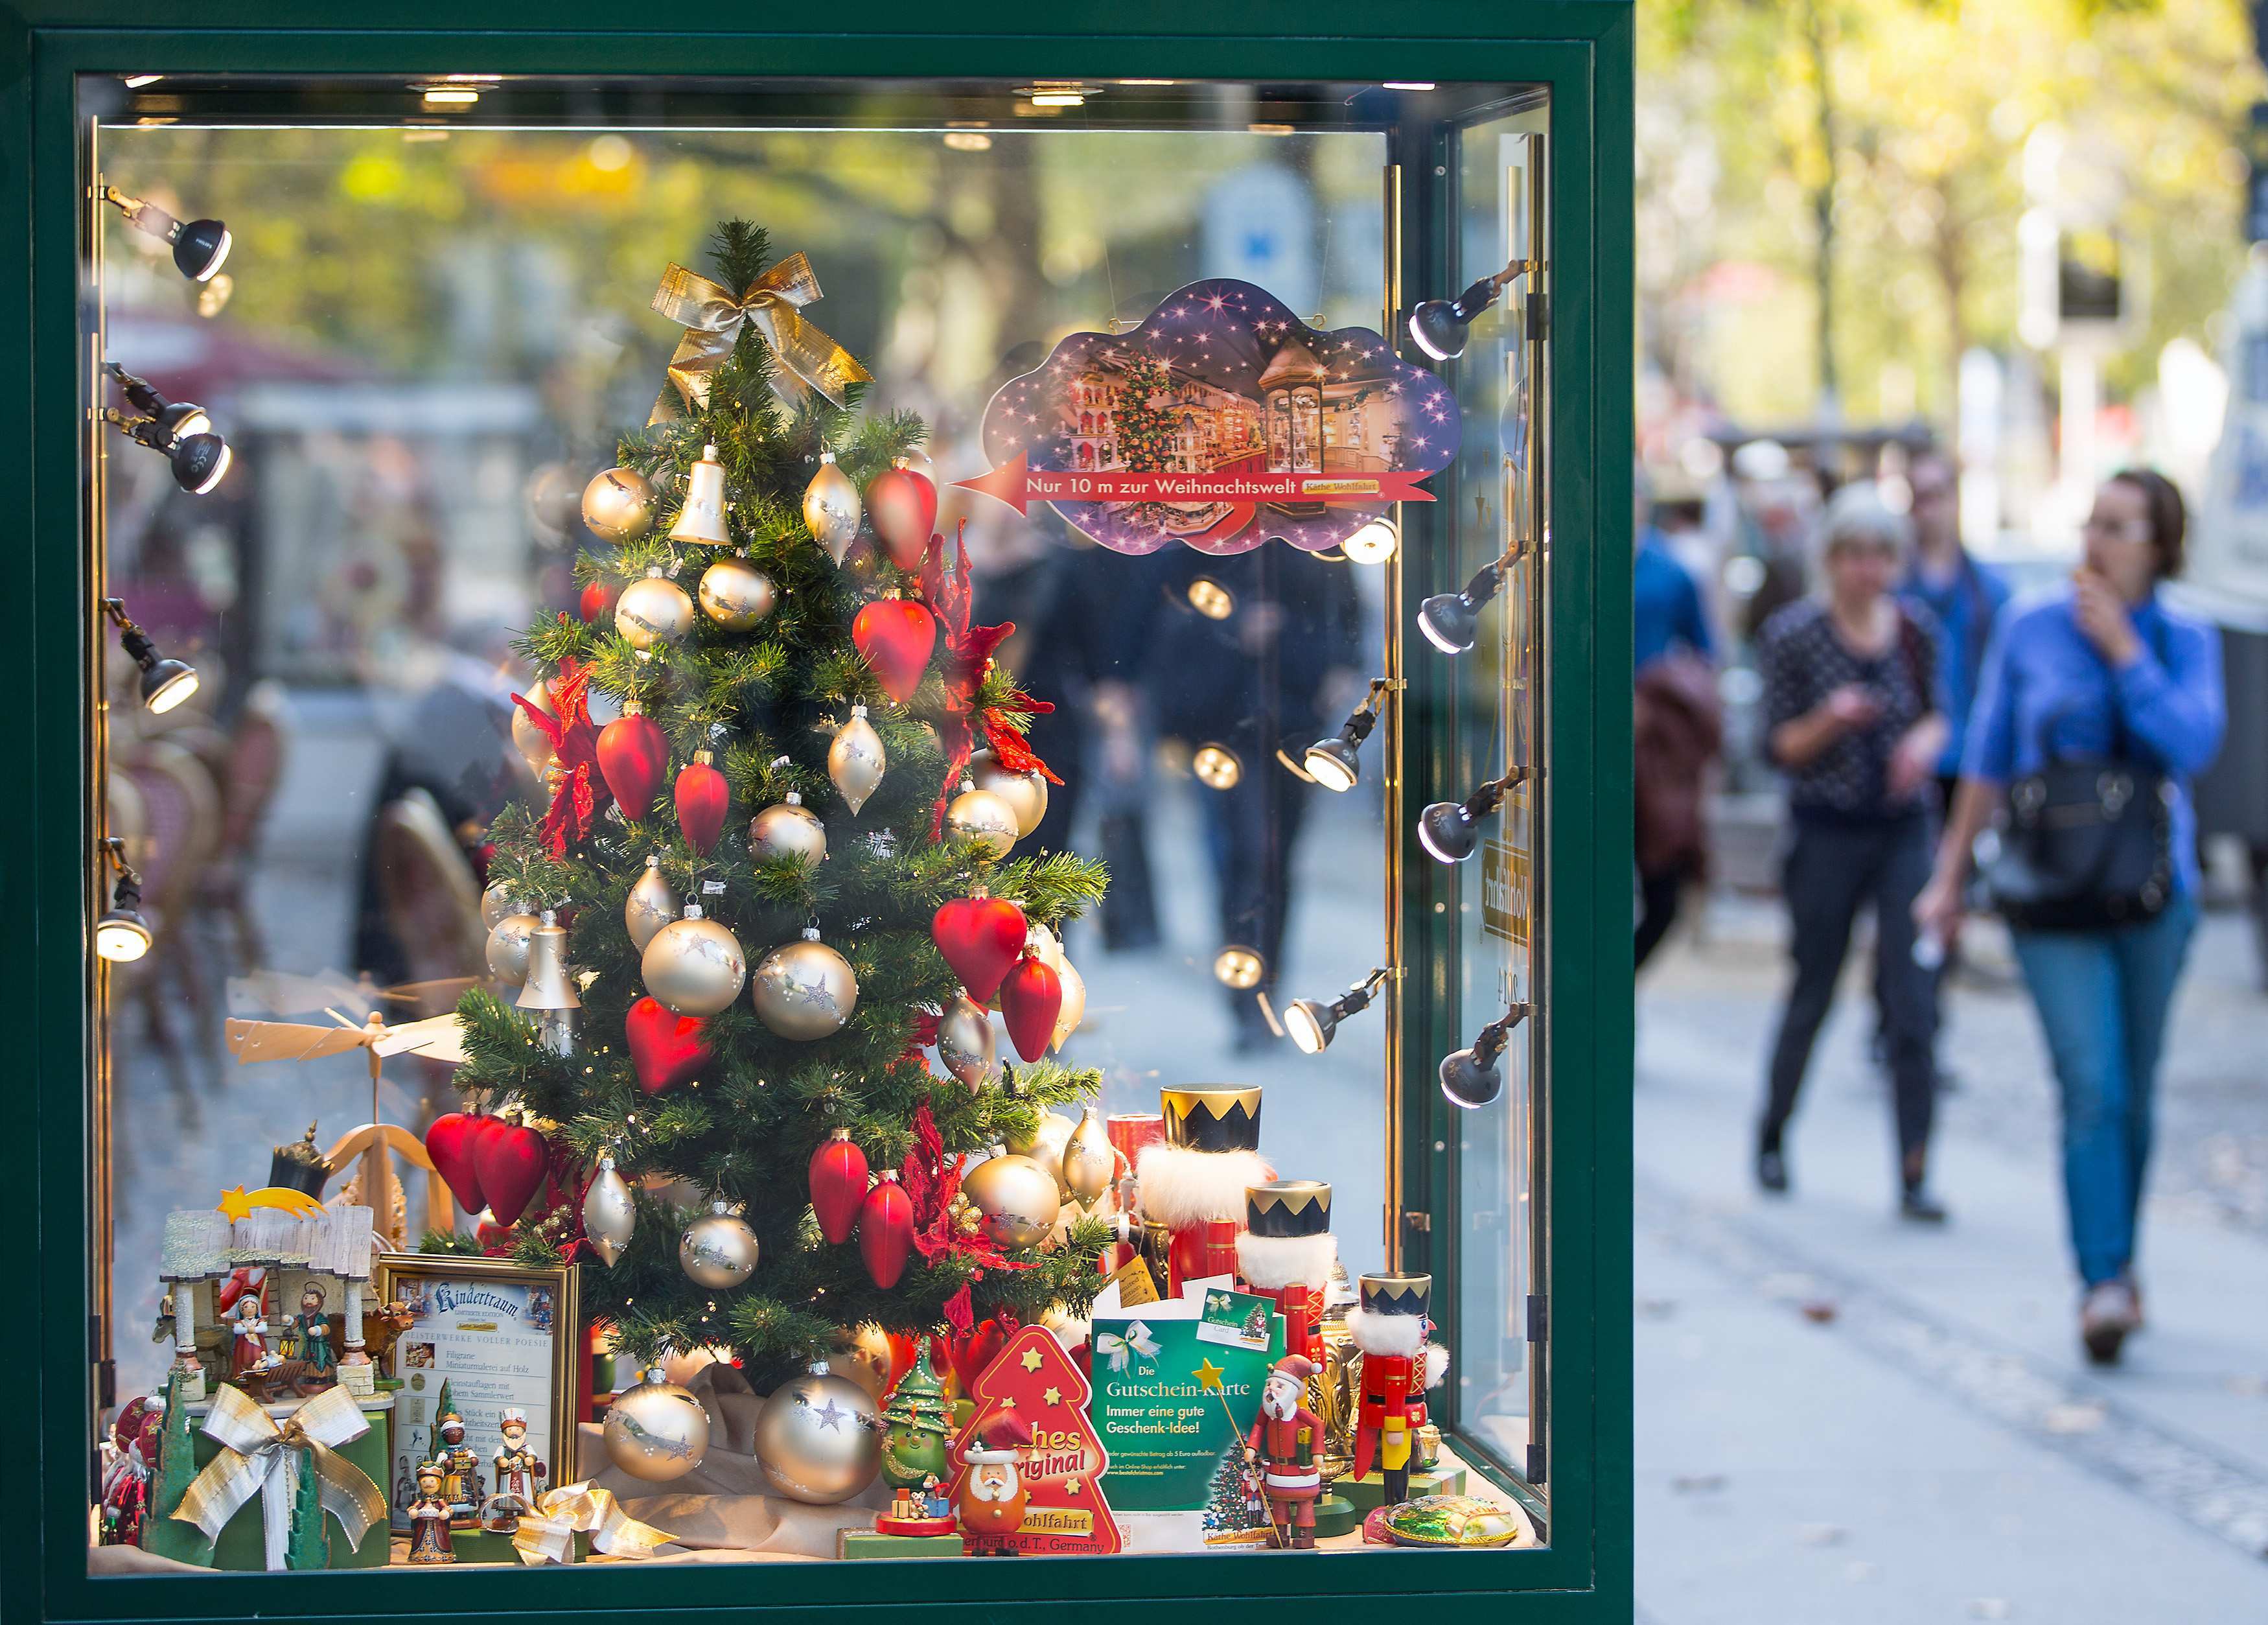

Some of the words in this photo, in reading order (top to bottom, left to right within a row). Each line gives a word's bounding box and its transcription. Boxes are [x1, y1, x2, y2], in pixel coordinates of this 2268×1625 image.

[1026, 478, 1062, 493] Nur
[1070, 478, 1092, 493] 10
[1098, 482, 1113, 493] m
[1120, 482, 1149, 494] zur
[1154, 477, 1297, 495] Weihnachtswelt
[1306, 482, 1331, 491] Käthe
[1334, 482, 1377, 491] Wohlfahrt
[435, 1281, 519, 1317] Kindertraum
[1207, 1316, 1238, 1328] Gutschein
[1214, 1325, 1230, 1333] Card
[404, 1331, 472, 1342] MEISTERWERKE
[477, 1335, 511, 1345] VOLLER
[516, 1338, 548, 1348] POESIE
[446, 1350, 476, 1361] Filigrane
[446, 1361, 498, 1372] Miniaturmalerei
[500, 1364, 511, 1372] auf
[513, 1365, 529, 1374] Holz
[1139, 1366, 1155, 1375] Die
[465, 1409, 483, 1418] Stück
[1106, 1405, 1145, 1417] Immer
[1148, 1405, 1174, 1417] eine
[1177, 1405, 1205, 1420] gute
[1106, 1420, 1199, 1434] Geschenk-Idee!
[1015, 1449, 1085, 1480] riginal
[1023, 1513, 1088, 1530] ohlfahrt
[1049, 1538, 1105, 1554] Germany
